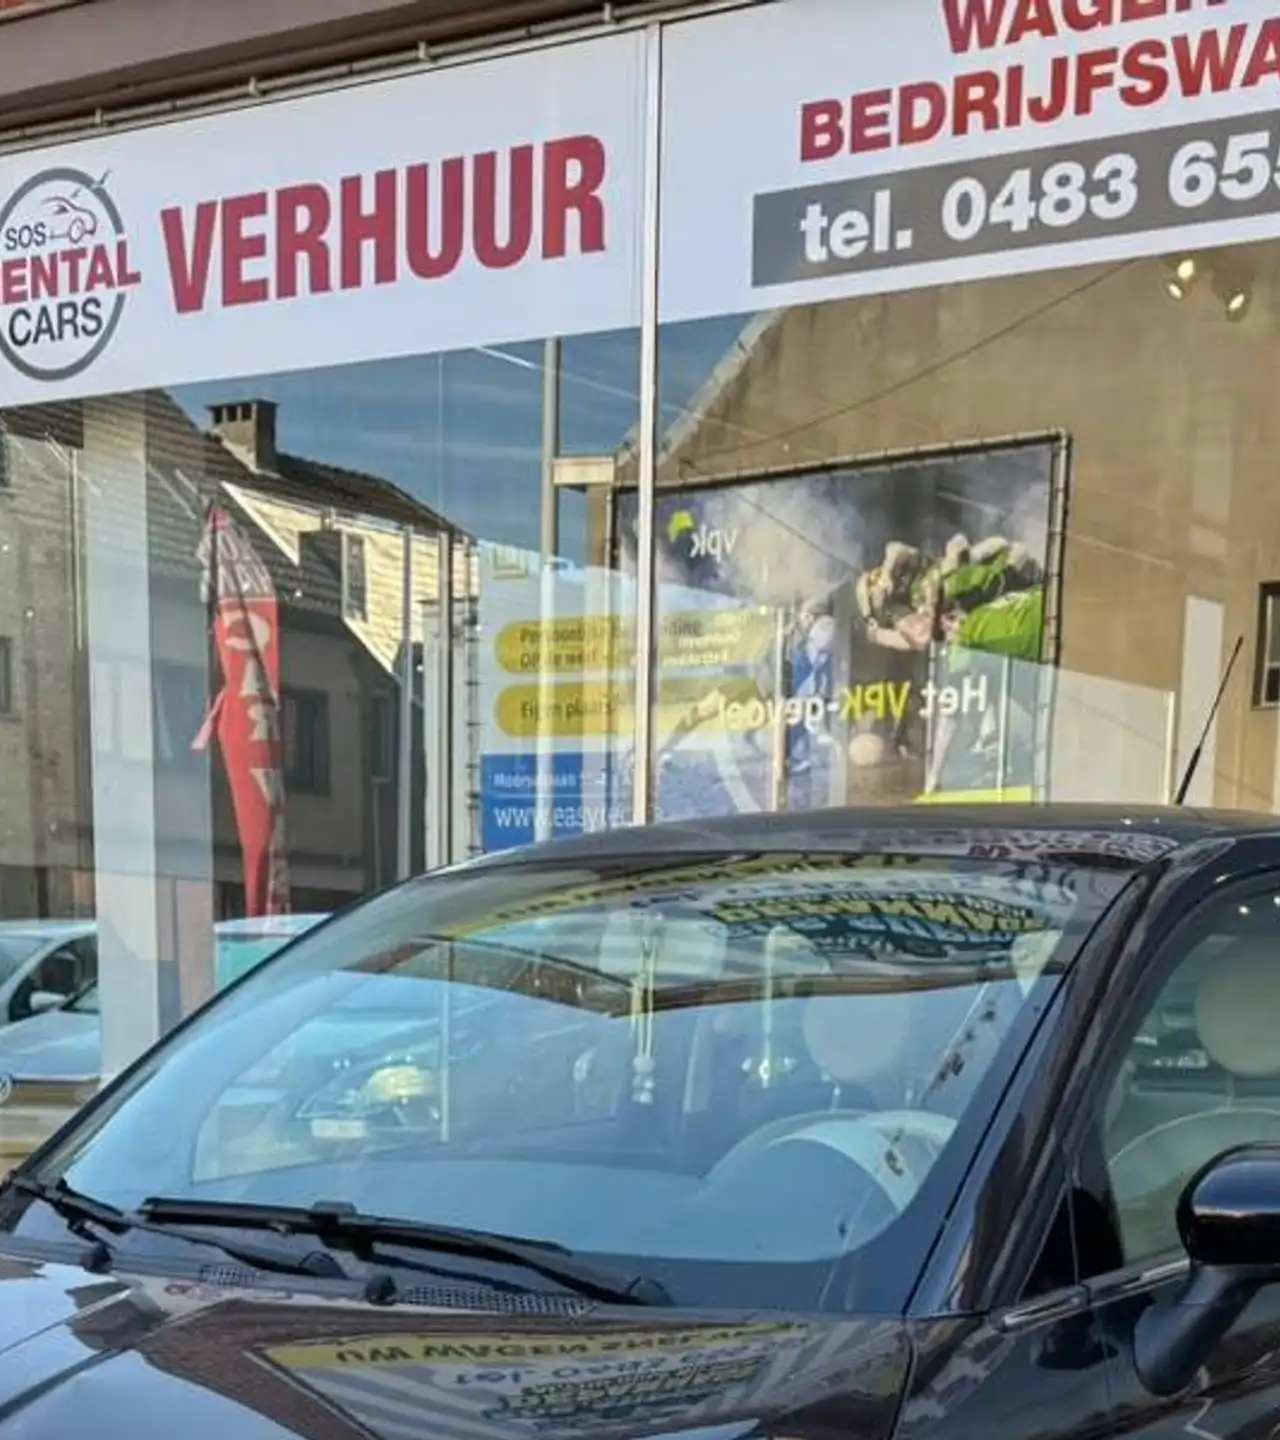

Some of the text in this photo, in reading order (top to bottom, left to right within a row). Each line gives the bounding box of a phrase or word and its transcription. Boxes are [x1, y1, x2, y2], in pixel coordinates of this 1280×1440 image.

[4, 221, 47, 252] SOS
[160, 133, 607, 315] VERHUUR
[799, 190, 913, 264] tel.
[942, 152, 1140, 241] 0483
[8, 296, 104, 349] CARS
